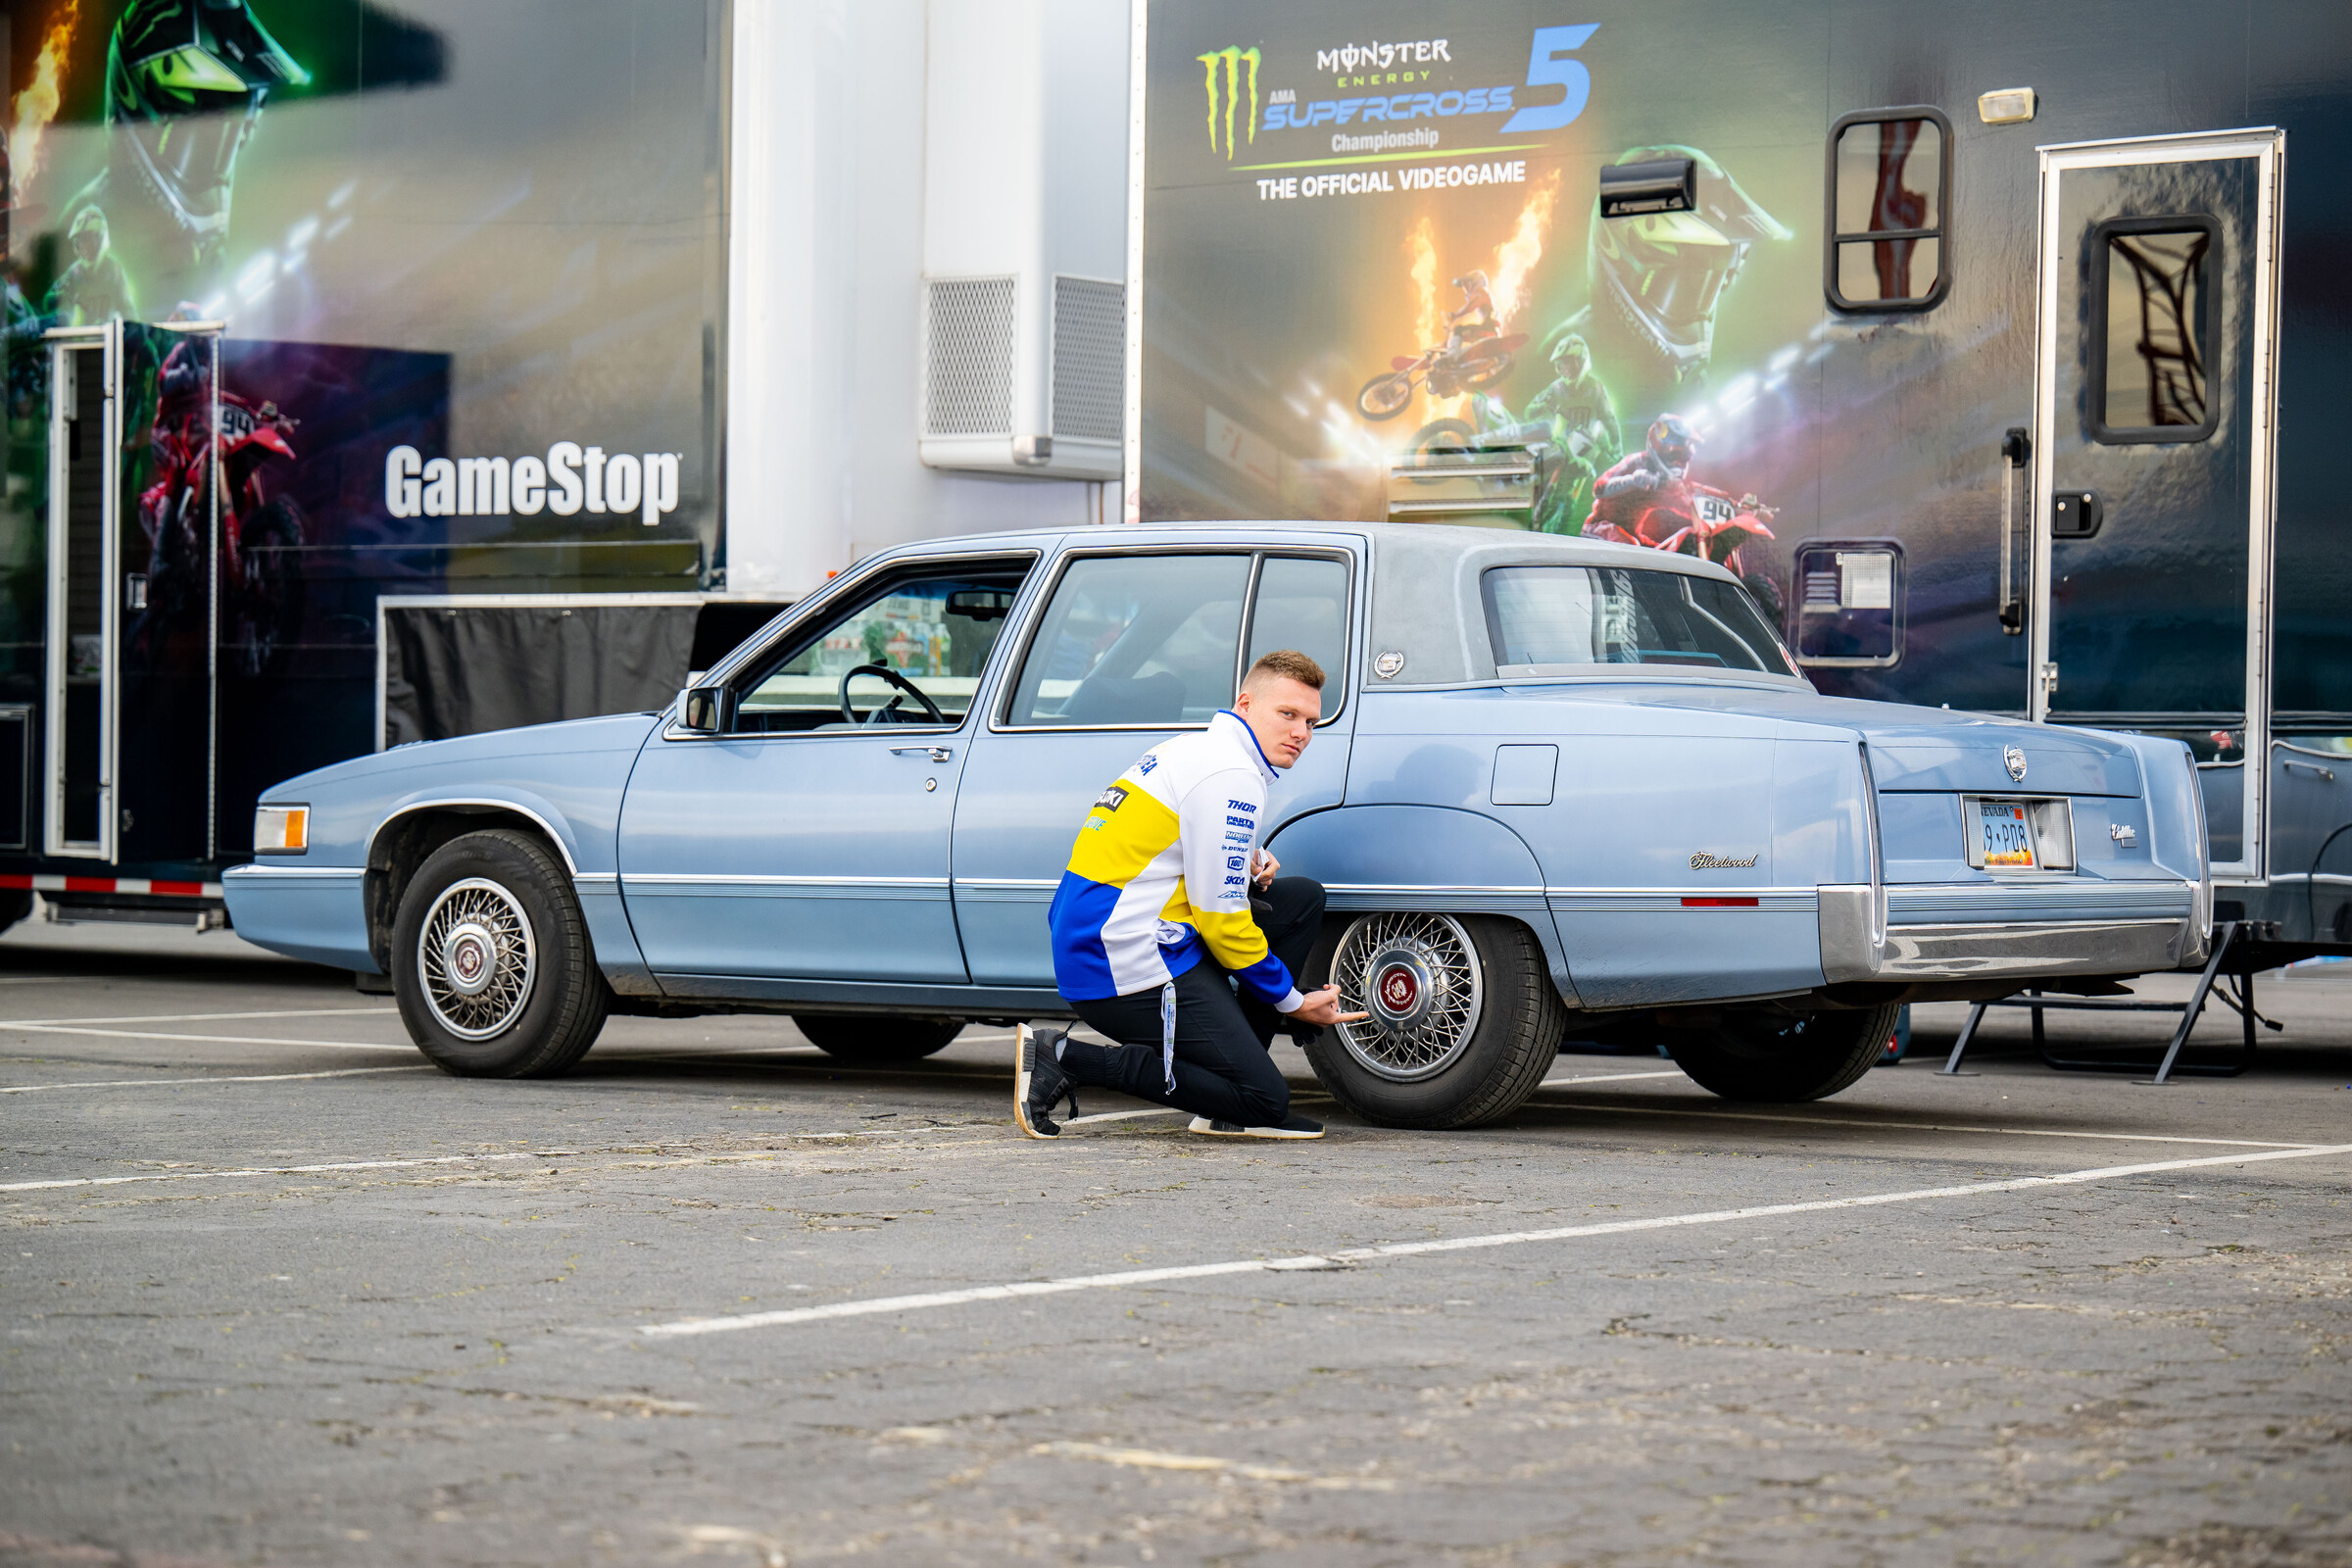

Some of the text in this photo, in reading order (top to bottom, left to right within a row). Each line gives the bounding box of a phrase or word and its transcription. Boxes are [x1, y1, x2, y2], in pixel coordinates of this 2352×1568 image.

[1337, 70, 1431, 88] ENERGY
[1499, 22, 1601, 133] 5
[1260, 85, 1516, 131] SUPERCROSS
[1269, 89, 1297, 105] AMA
[1331, 126, 1440, 153] Championship
[1256, 160, 1527, 201] THE OFFICIAL VIDEOGAME
[220, 409, 254, 436] 94
[384, 440, 680, 526] GameStop
[1702, 500, 1733, 521] 94
[1228, 799, 1256, 813] THOR
[1689, 851, 1758, 870] Fleetwood
